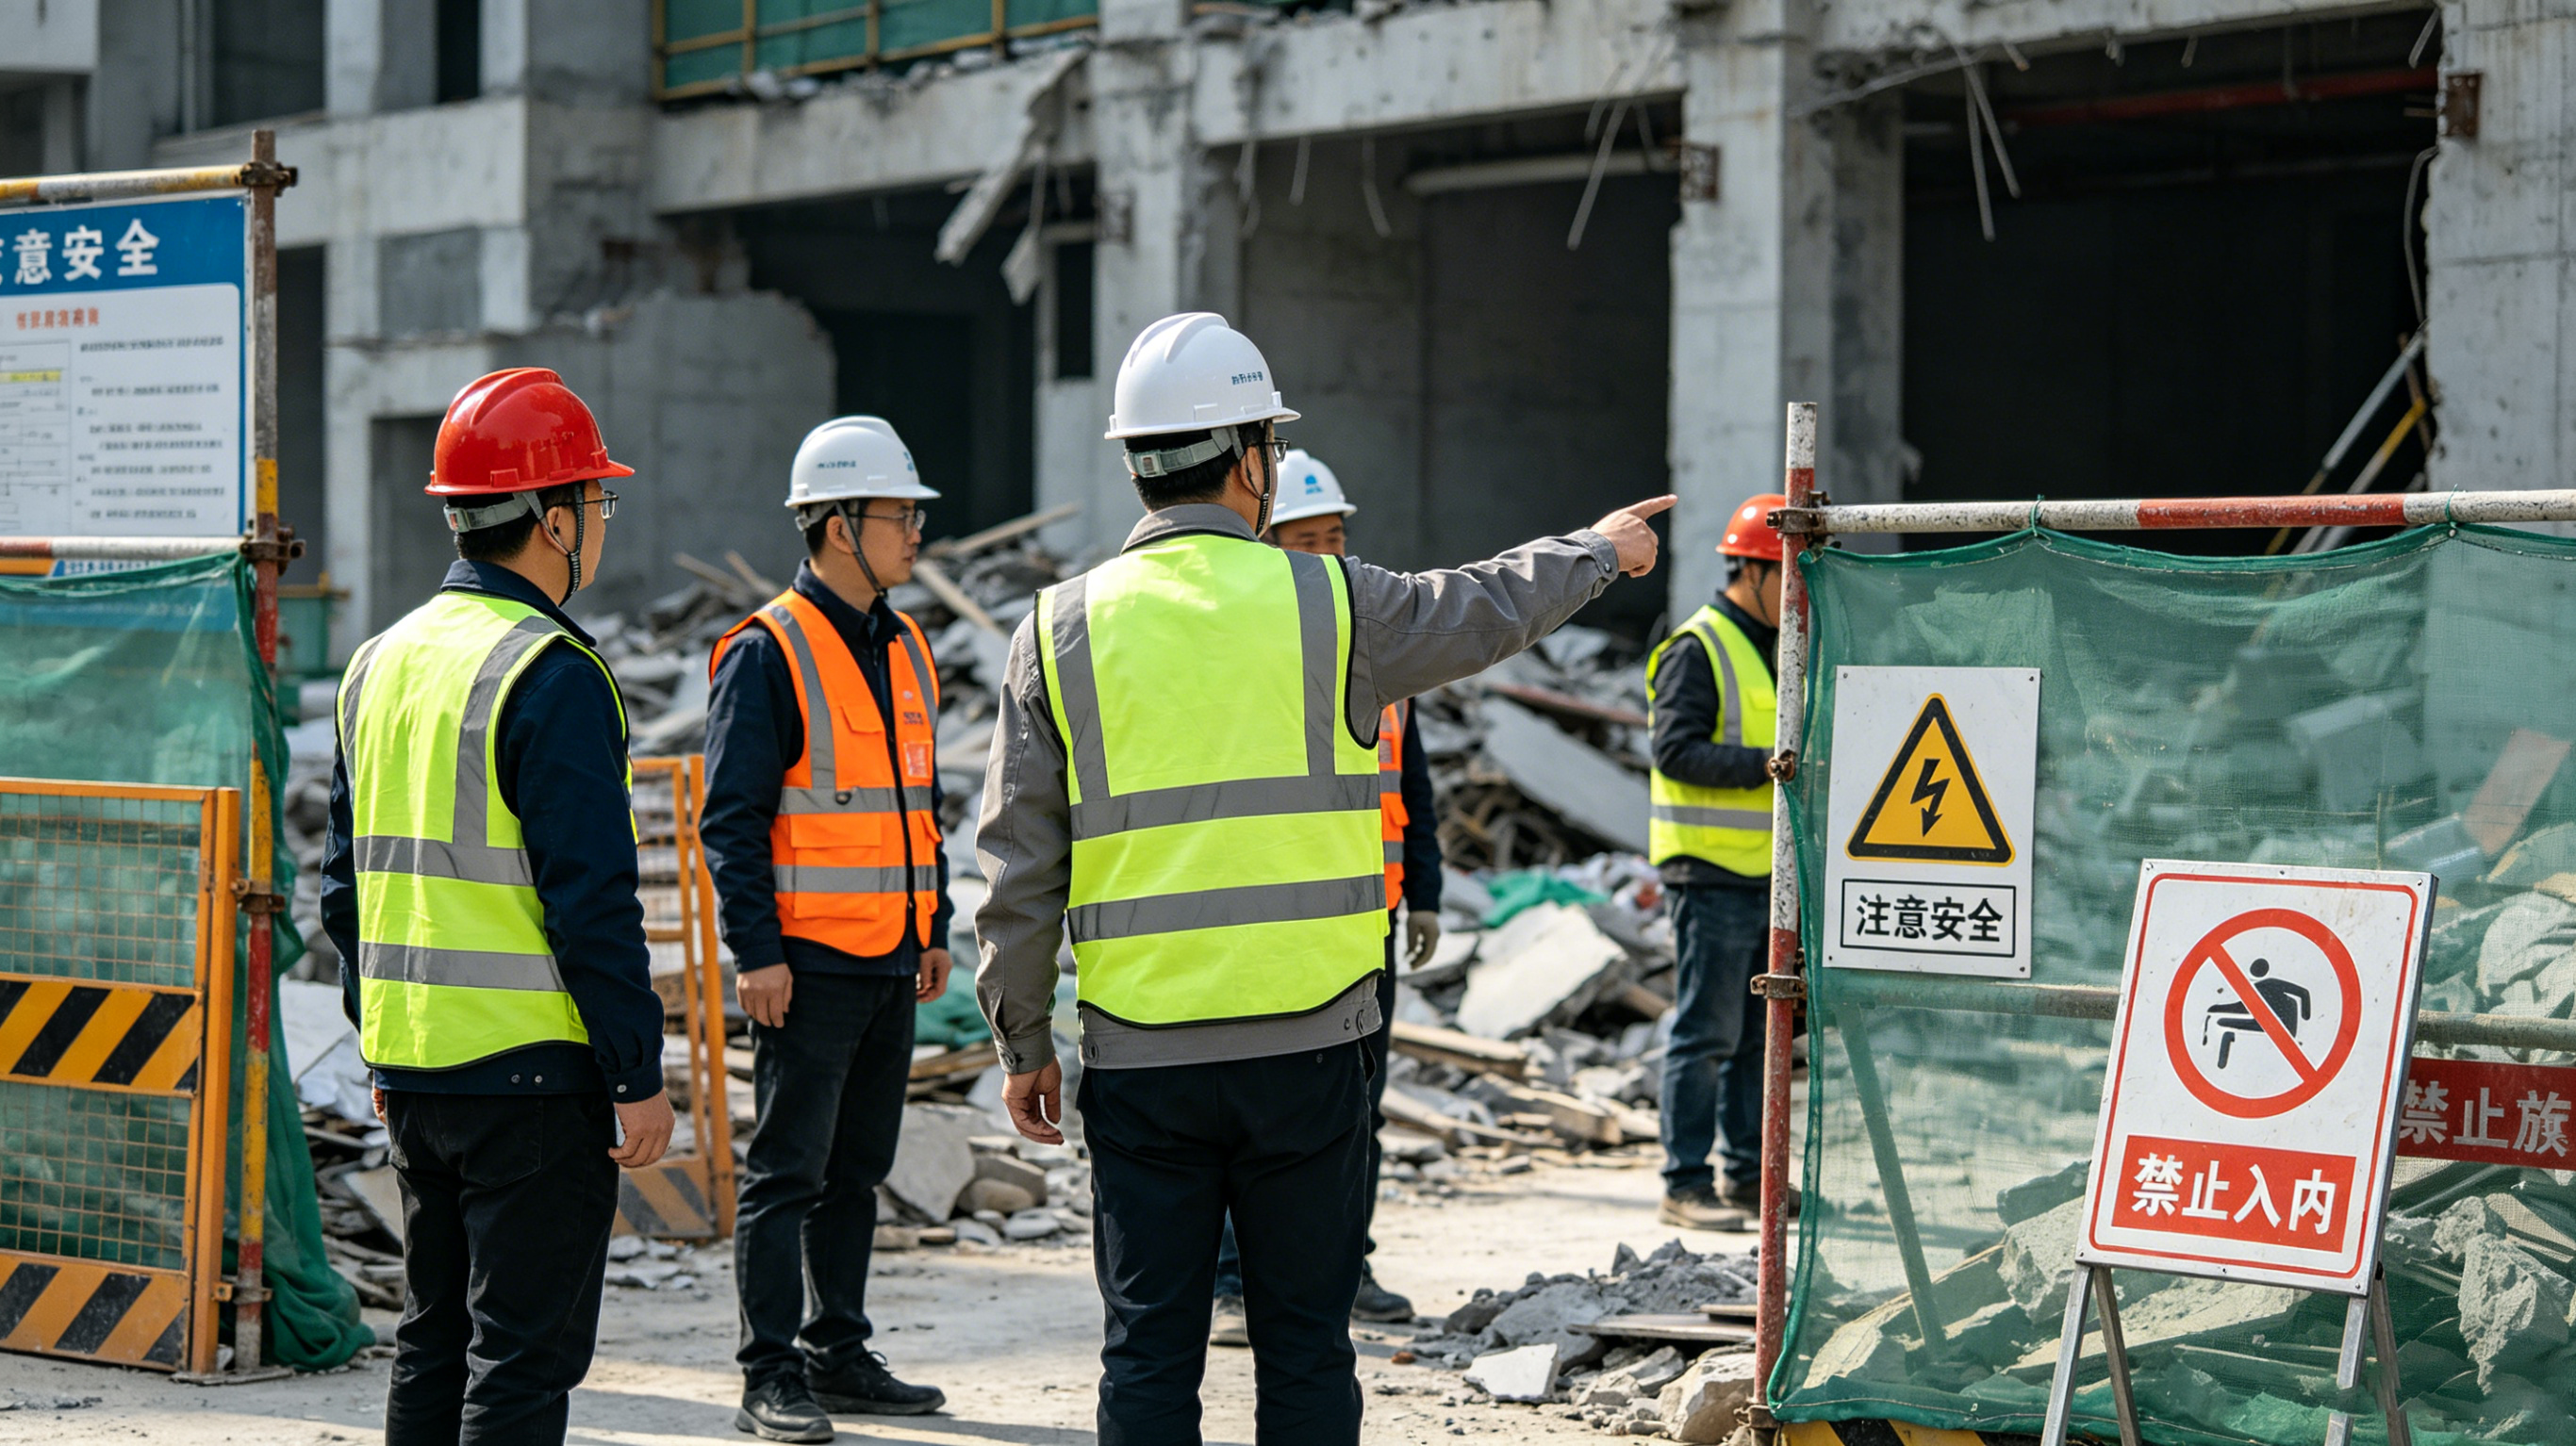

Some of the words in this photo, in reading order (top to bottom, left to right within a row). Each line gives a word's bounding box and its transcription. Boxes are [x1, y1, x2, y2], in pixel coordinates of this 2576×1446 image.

[0, 218, 159, 286] 意安全
[1856, 893, 2004, 943] 注意安全
[2130, 1152, 2337, 1235] 禁止入内
